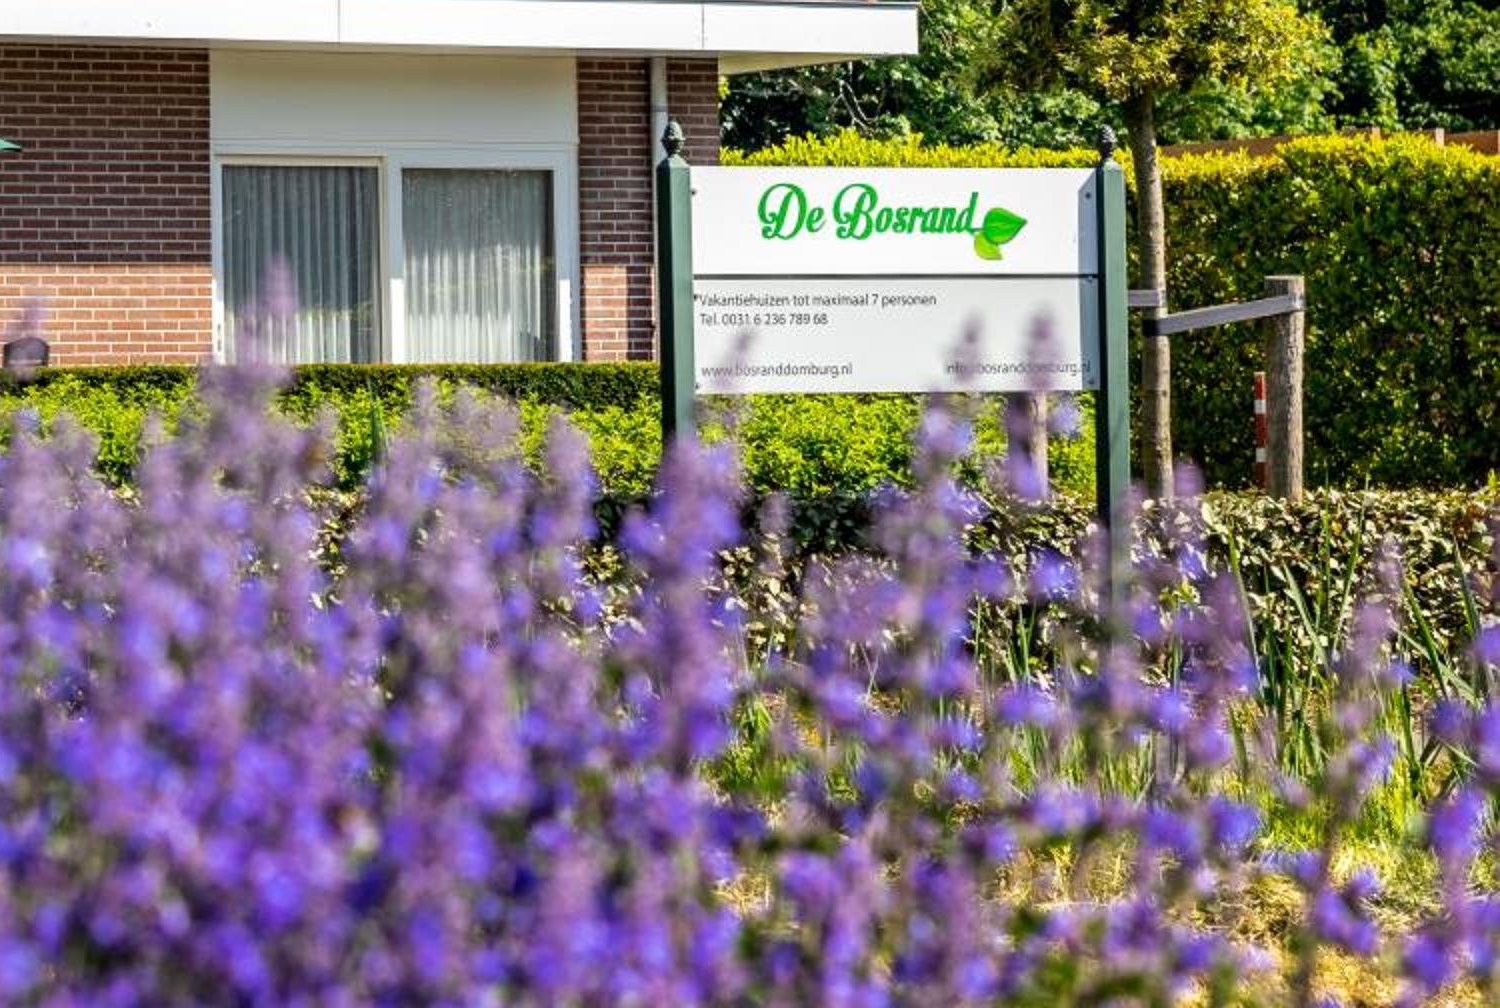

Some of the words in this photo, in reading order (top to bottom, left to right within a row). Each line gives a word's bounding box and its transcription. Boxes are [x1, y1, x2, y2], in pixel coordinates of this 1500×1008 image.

[757, 182, 826, 241] De
[831, 182, 984, 241] Bosrand
[700, 293, 790, 307] Vakantiehuizen
[792, 294, 810, 307] tot
[812, 293, 870, 307] maximaal
[871, 293, 879, 306] 7
[881, 294, 938, 310] personen
[700, 312, 719, 325] Tel.
[721, 312, 750, 325] 0031
[753, 312, 762, 325] 6
[764, 312, 787, 325] 236
[789, 312, 812, 325] 789
[813, 312, 829, 325] 68
[701, 362, 853, 379] www.bosranddomburg.nl
